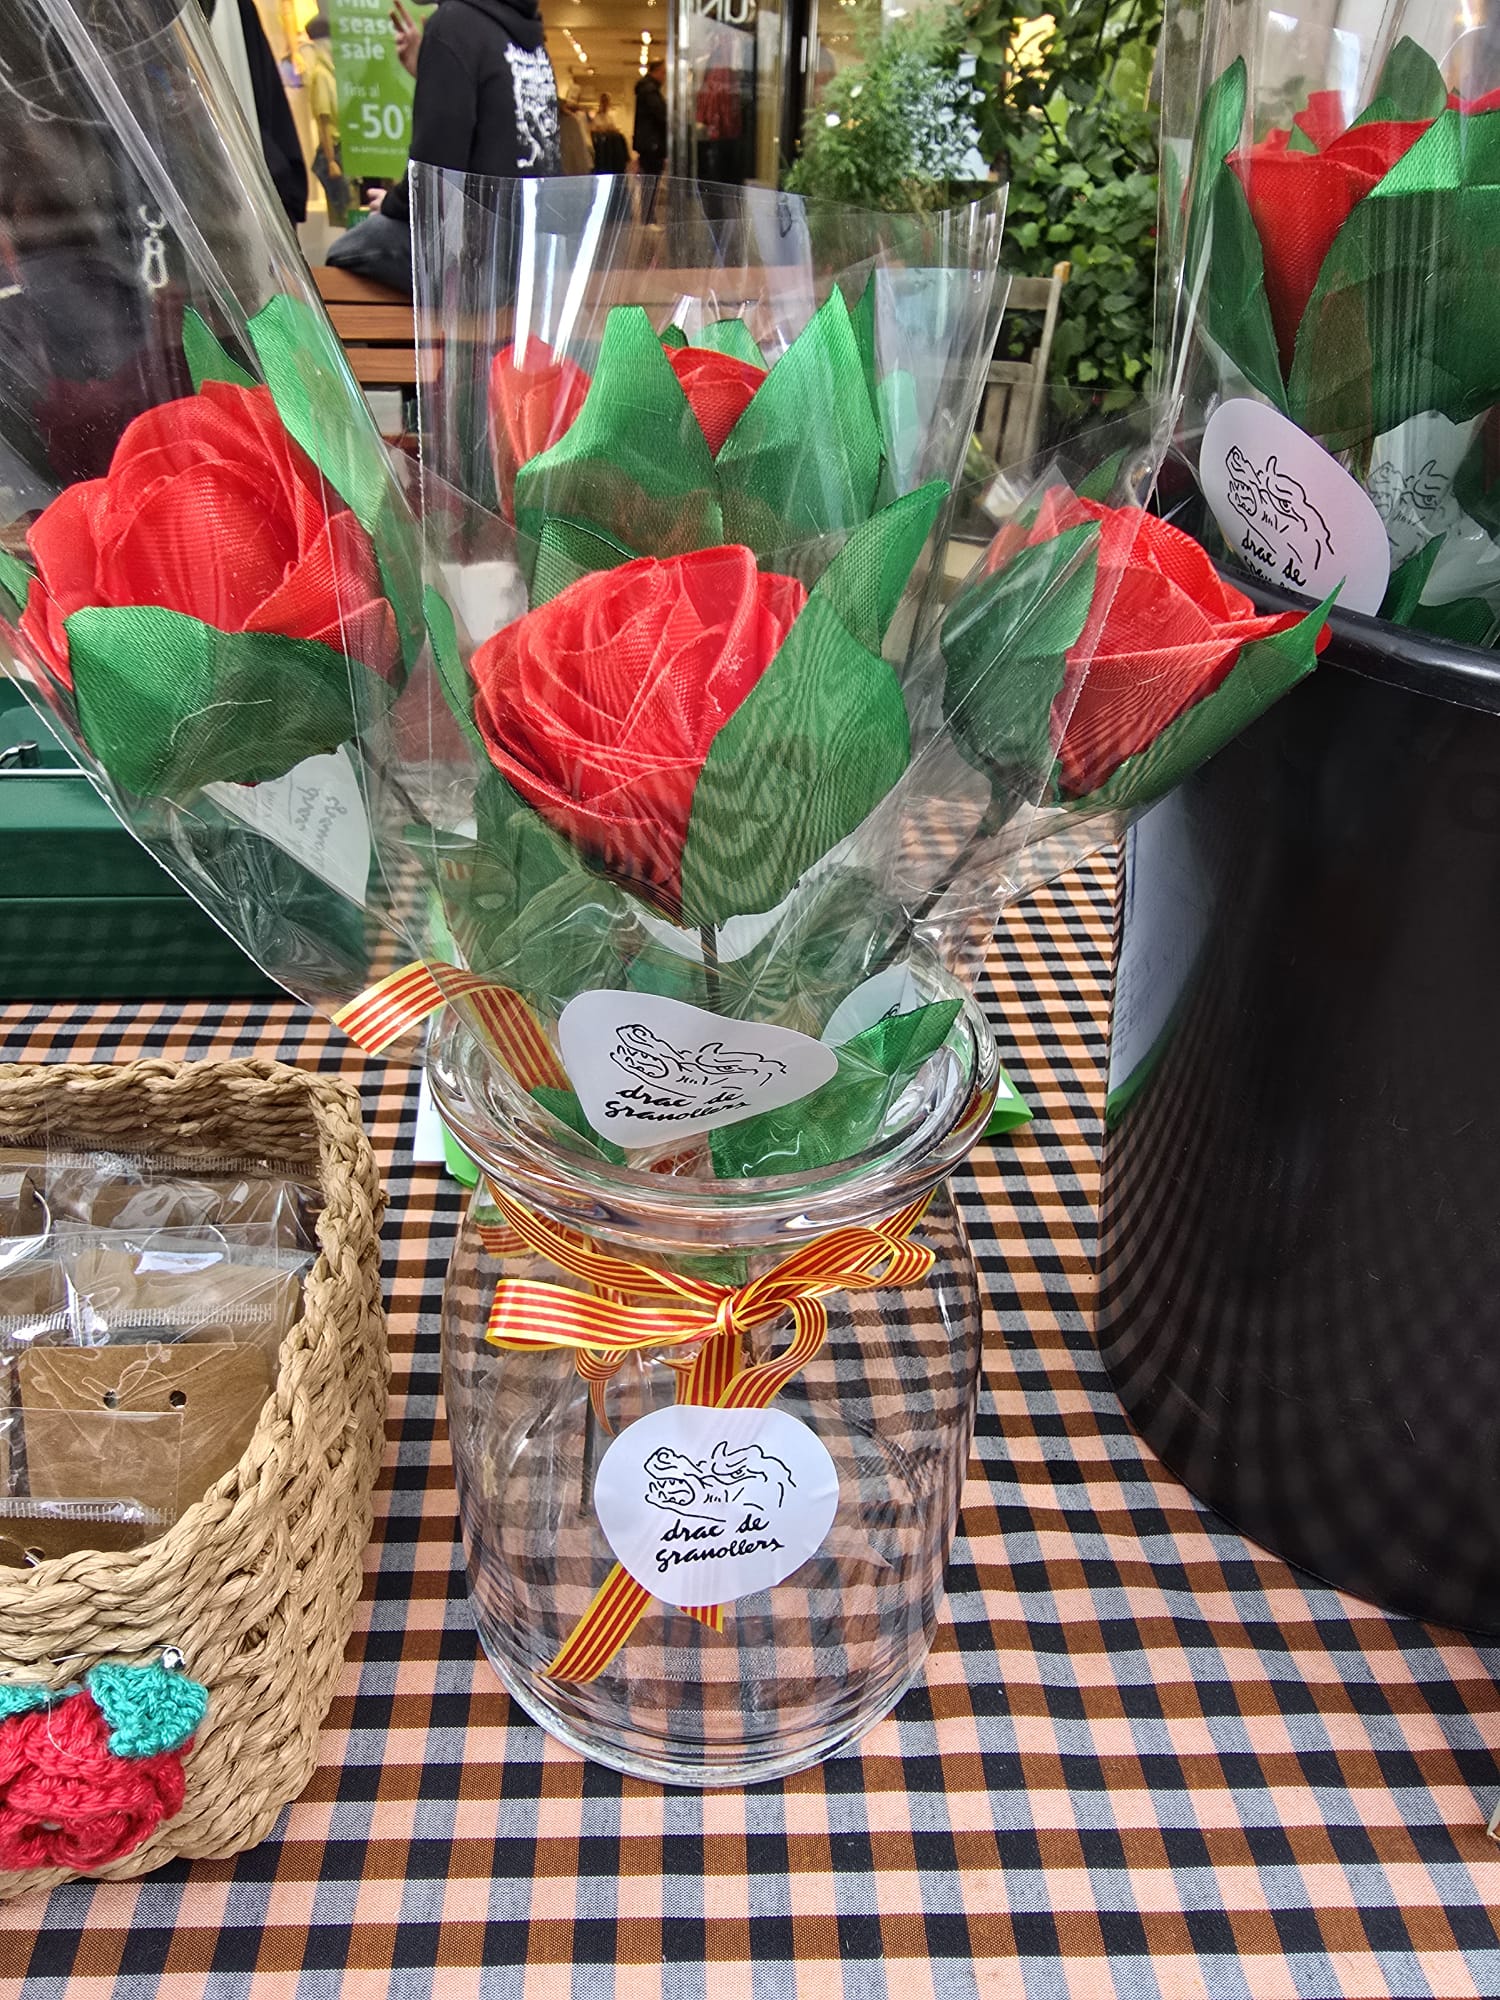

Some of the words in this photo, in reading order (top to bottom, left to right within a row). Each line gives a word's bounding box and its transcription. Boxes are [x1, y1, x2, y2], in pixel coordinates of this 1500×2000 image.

[338, 16, 408, 35] seas
[341, 36, 385, 60] sale
[1241, 529, 1276, 567] drac
[1282, 557, 1307, 587] de
[616, 1084, 692, 1107] drac
[703, 1091, 745, 1105] de
[604, 1100, 751, 1121] granollers
[660, 1518, 725, 1542] drac
[735, 1513, 770, 1533] de
[655, 1537, 785, 1573] granollers
